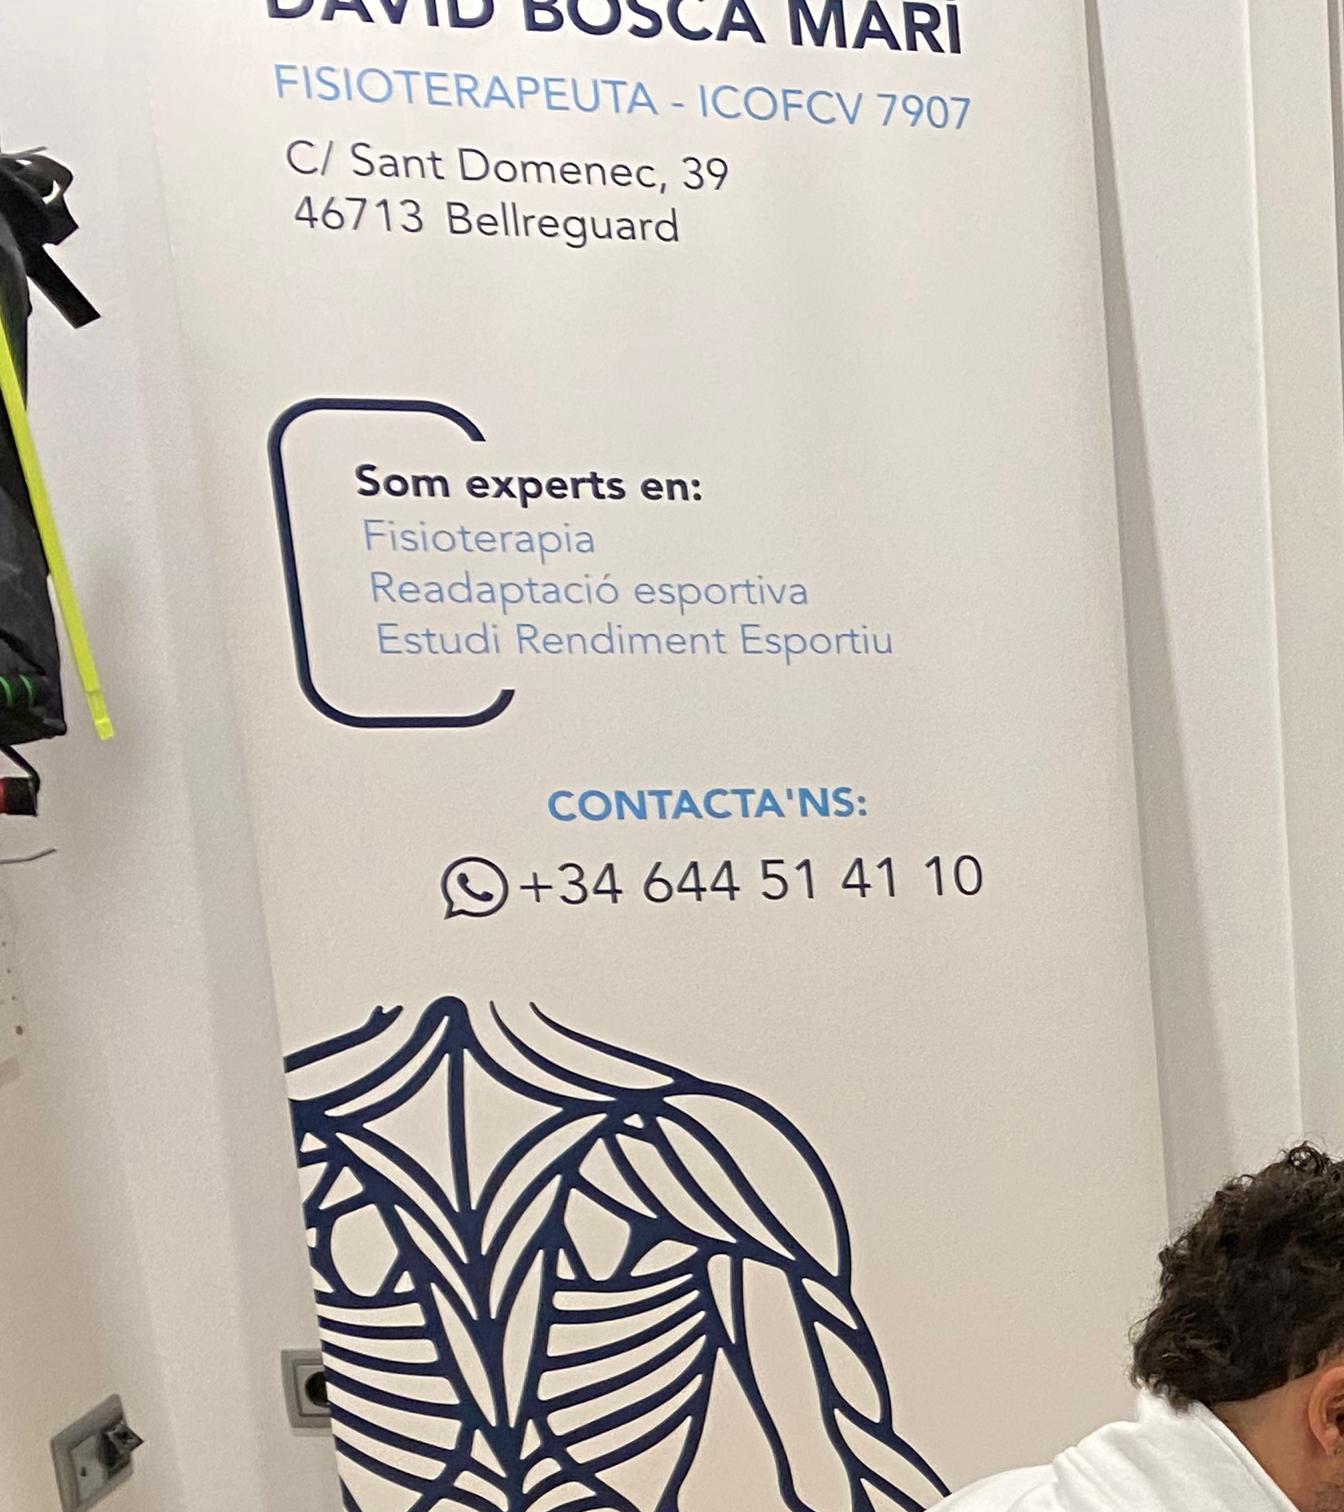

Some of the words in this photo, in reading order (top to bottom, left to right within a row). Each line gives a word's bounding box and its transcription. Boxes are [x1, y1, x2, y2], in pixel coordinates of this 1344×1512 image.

[523, 0, 767, 44] BOSCA
[273, 63, 659, 115] FISIOTERAPEUTA
[699, 84, 863, 127] ICOFCV
[876, 93, 972, 131] 7907
[285, 139, 334, 176] C/
[350, 142, 445, 181] Sant
[458, 147, 668, 194] Domenec,
[682, 157, 729, 191] 39
[294, 195, 425, 234] 46713
[446, 201, 681, 249] Bellreguard
[354, 463, 451, 499] Som
[465, 470, 627, 510] experts
[639, 475, 703, 502] en:
[362, 519, 597, 565] Fisioterapia
[369, 572, 621, 616] Readaptació
[633, 574, 809, 617] esportiva
[376, 622, 501, 656] Estudi
[516, 624, 727, 656] Rendiment
[740, 623, 893, 667] Esportiu
[547, 785, 868, 822] CONTACTA'NS:
[519, 861, 624, 905] +34
[642, 860, 741, 904] 644
[760, 857, 817, 900] 51
[840, 856, 897, 899] 41
[922, 853, 984, 898] 10
